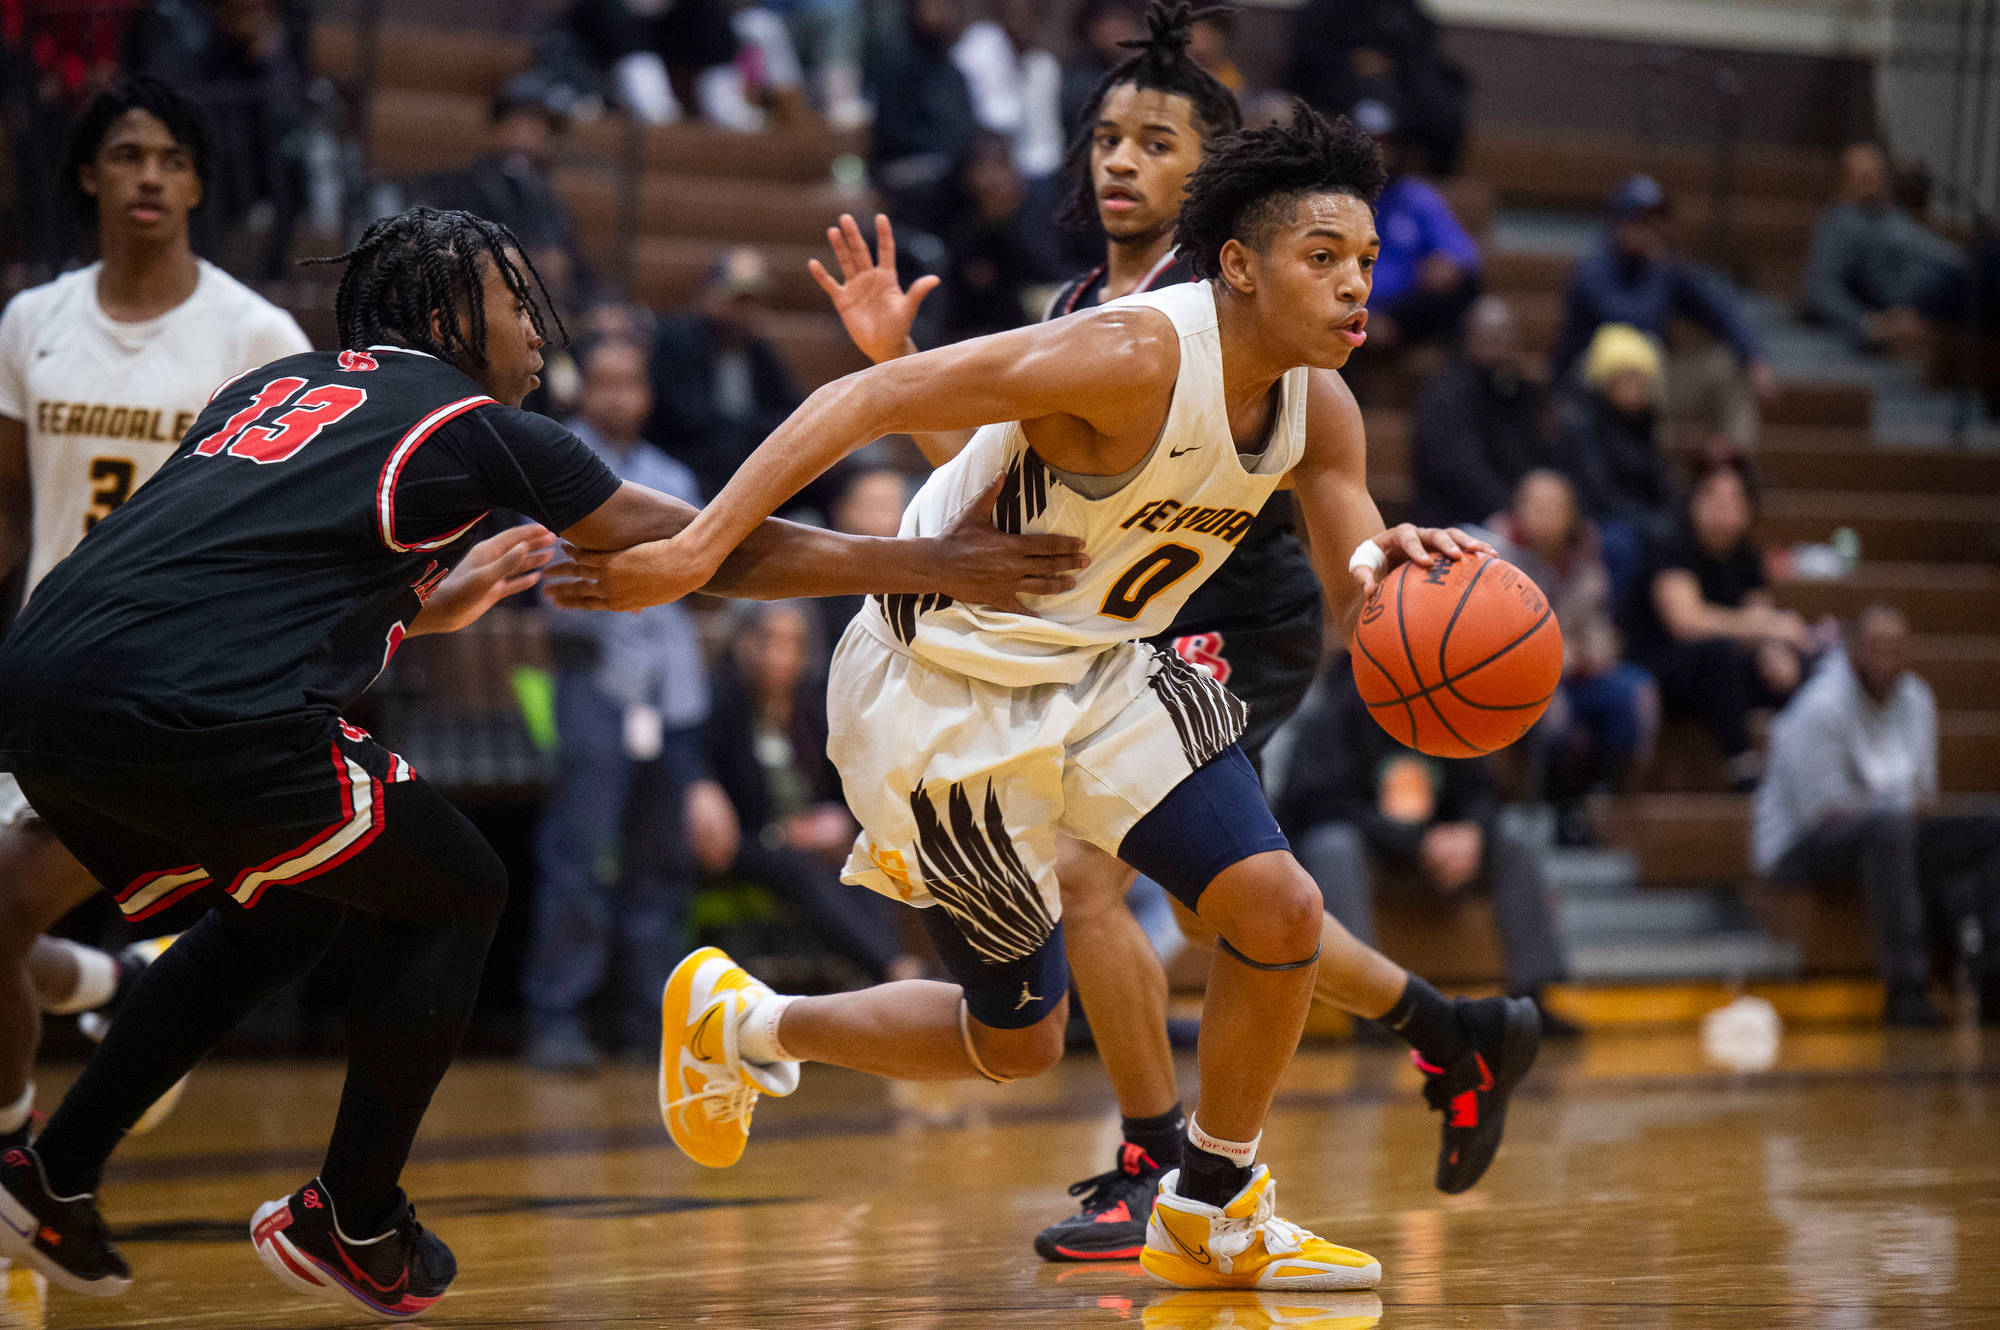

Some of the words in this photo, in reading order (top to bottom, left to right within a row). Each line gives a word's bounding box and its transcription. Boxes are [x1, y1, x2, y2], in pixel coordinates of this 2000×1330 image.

[37, 401, 195, 444] FERNDALE
[190, 376, 367, 465] 13
[1097, 541, 1204, 622] 0
[1192, 1124, 1251, 1155] Supreme
